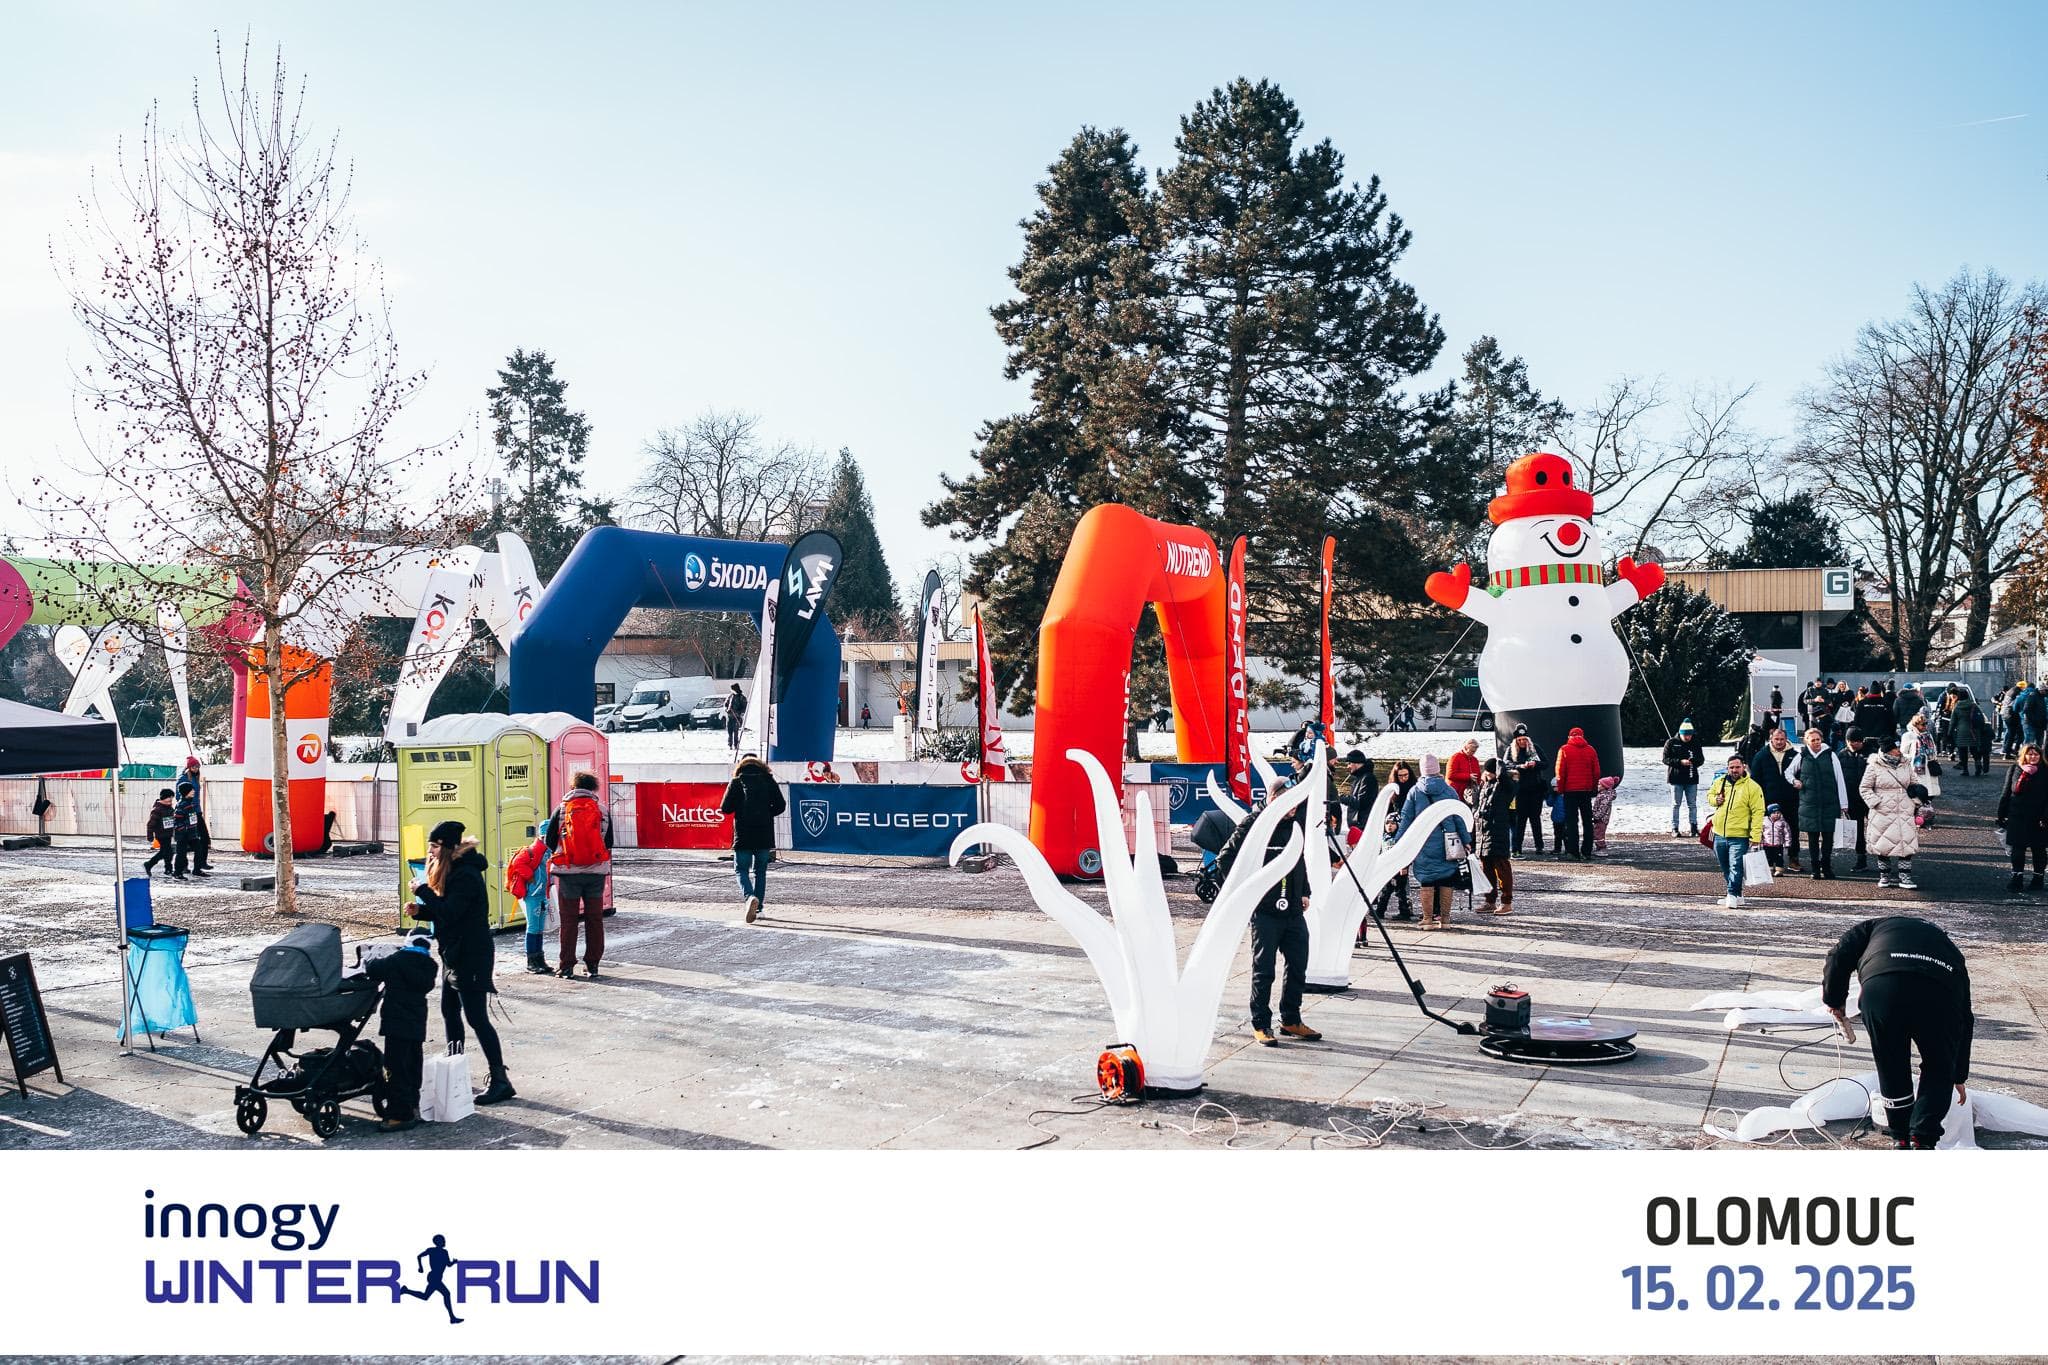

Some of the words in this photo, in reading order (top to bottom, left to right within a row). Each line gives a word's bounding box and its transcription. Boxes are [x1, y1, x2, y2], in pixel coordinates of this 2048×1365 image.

[1165, 541, 1212, 578] NUTREND
[708, 556, 767, 590] ŠKODA
[1827, 572, 1850, 594] G
[441, 792, 456, 802] SERVIS
[661, 803, 725, 822] Nartes
[836, 812, 968, 828] PEUGEOT
[1890, 952, 1953, 972] www.winter-run.cz
